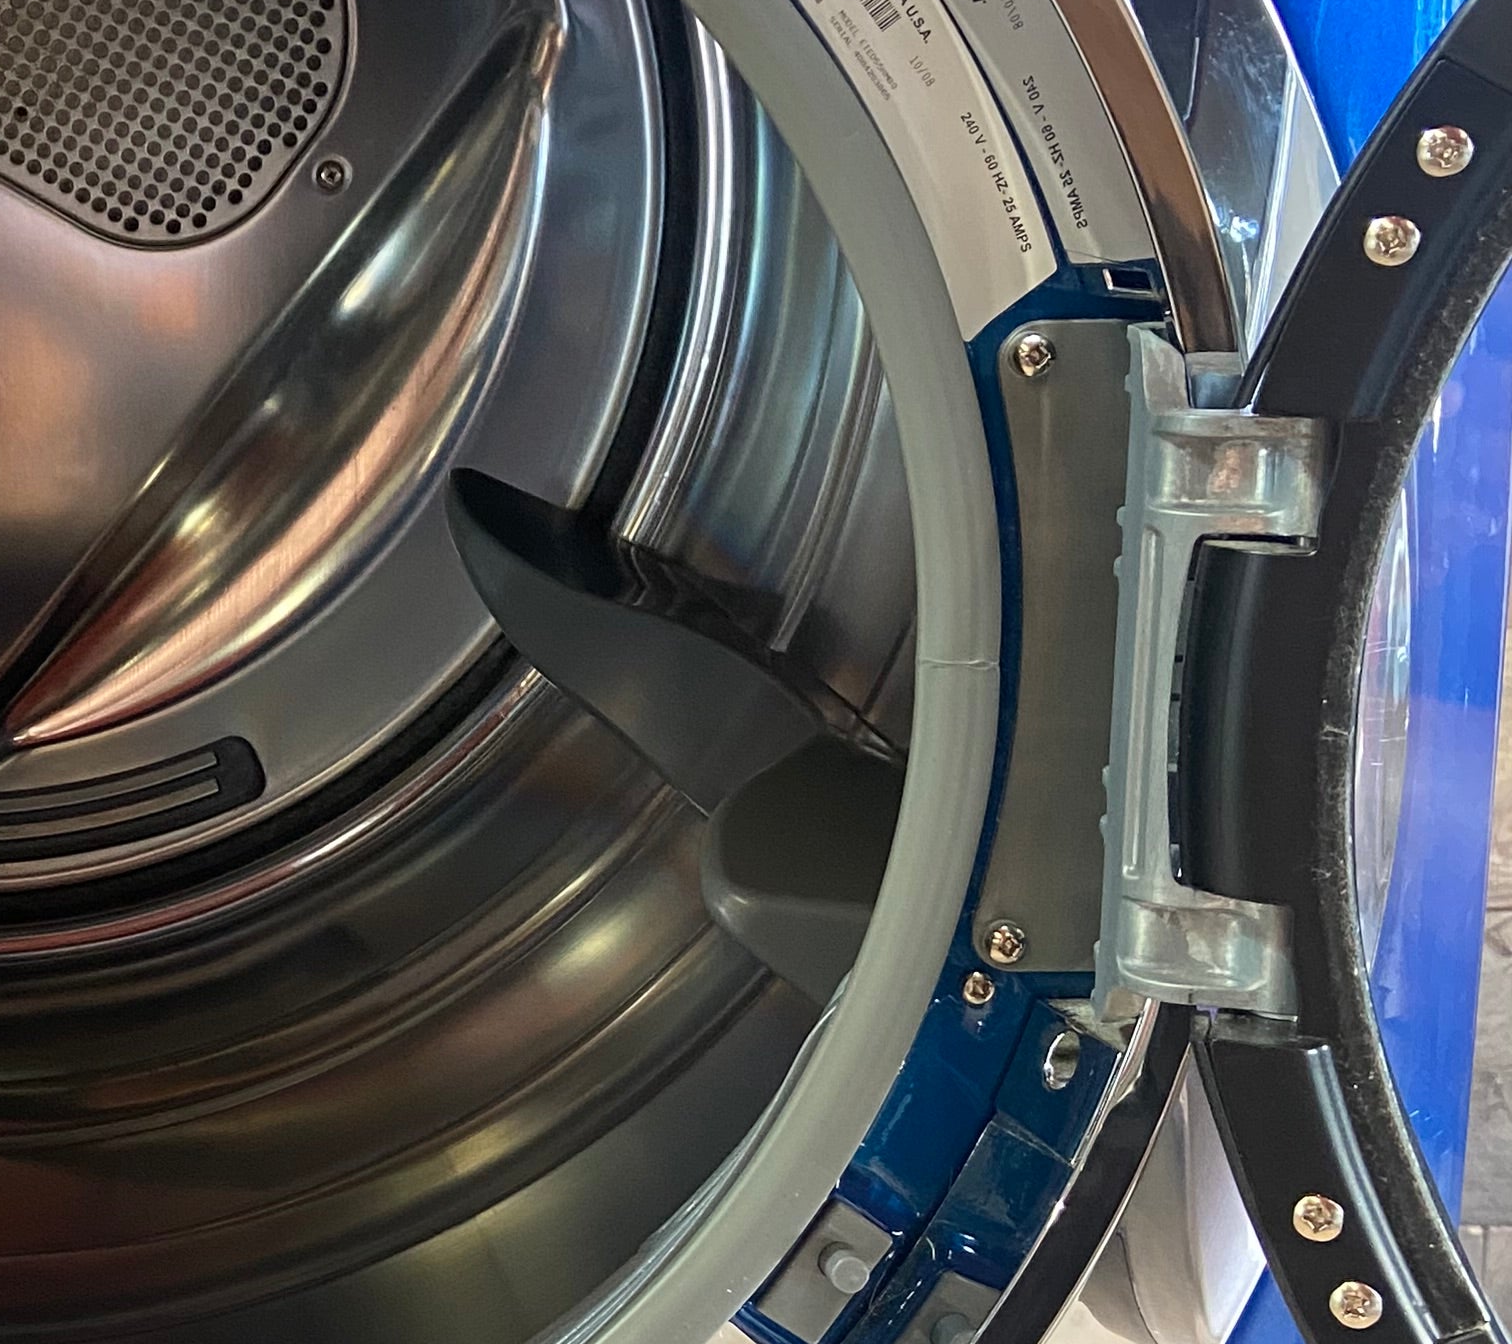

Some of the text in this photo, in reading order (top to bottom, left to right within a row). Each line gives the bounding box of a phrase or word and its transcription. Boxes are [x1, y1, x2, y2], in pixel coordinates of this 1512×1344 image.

[905, 5, 932, 44] U.S.A.
[960, 112, 980, 134] 240
[975, 134, 987, 145] V
[984, 155, 999, 170] 60
[1002, 197, 1018, 213] 25
[1009, 215, 1033, 253] AMPS
